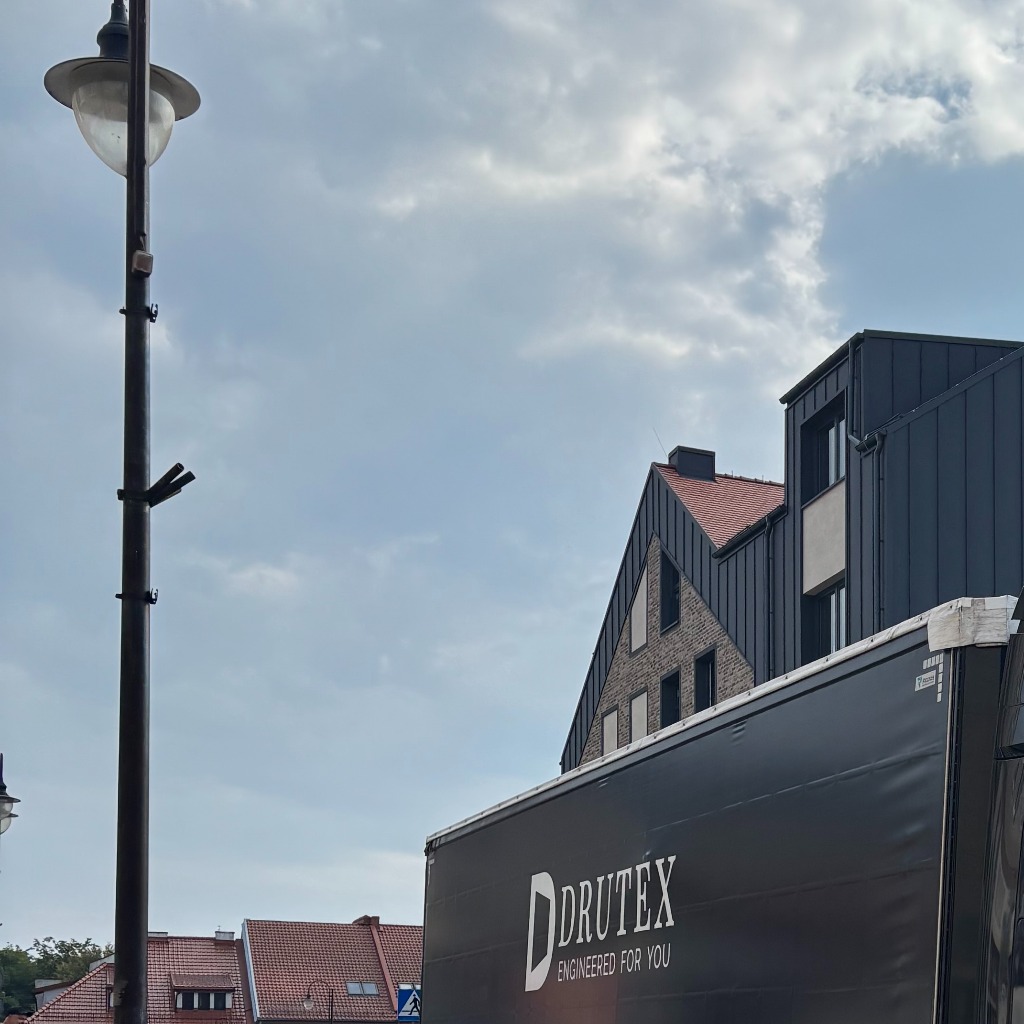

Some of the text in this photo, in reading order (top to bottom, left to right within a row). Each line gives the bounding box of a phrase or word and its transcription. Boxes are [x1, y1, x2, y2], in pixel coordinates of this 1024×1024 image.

[558, 855, 677, 948] DRUTEX
[557, 943, 671, 982] ENGINEERED FOR YOU
